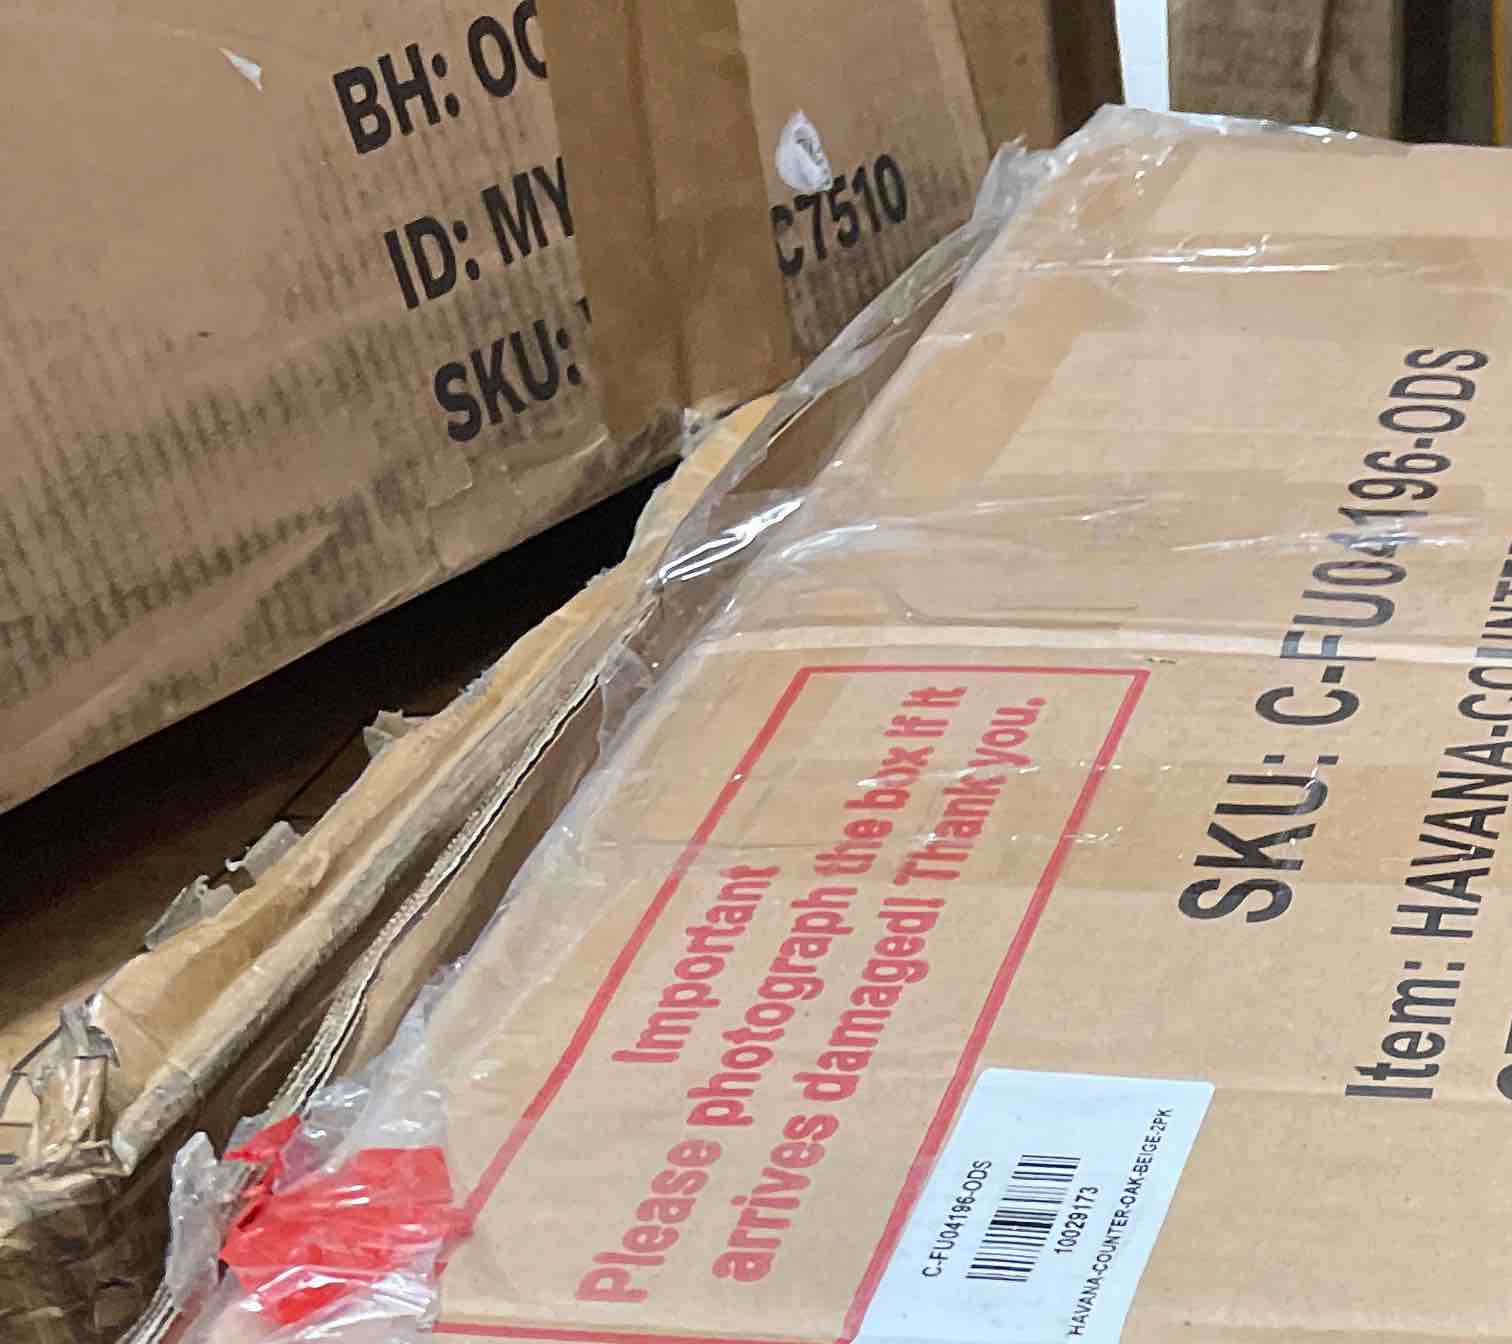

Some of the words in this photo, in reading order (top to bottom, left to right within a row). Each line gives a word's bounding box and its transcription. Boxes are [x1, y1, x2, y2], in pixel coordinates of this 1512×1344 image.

[333, 43, 460, 154] BH:
[384, 216, 480, 310] ID:
[434, 319, 582, 442] SKU:
[846, 744, 935, 812] box
[1178, 753, 1340, 923] SKU:
[816, 818, 894, 878] the
[612, 863, 781, 1063] Important
[688, 886, 858, 1126] photograph
[713, 1114, 838, 1283] arrives
[795, 895, 946, 1102] damaged!
[894, 776, 1008, 886] Thank
[968, 697, 1048, 767] you.
[1345, 960, 1465, 1100] Item:
[575, 1140, 721, 1304] Please
[922, 1160, 992, 1278] C-FU04196-ODS
[1054, 1186, 1099, 1254] 10029173
[1069, 1107, 1173, 1336] HAVANA-COUNTER-OAK-BEIGE-2PK
